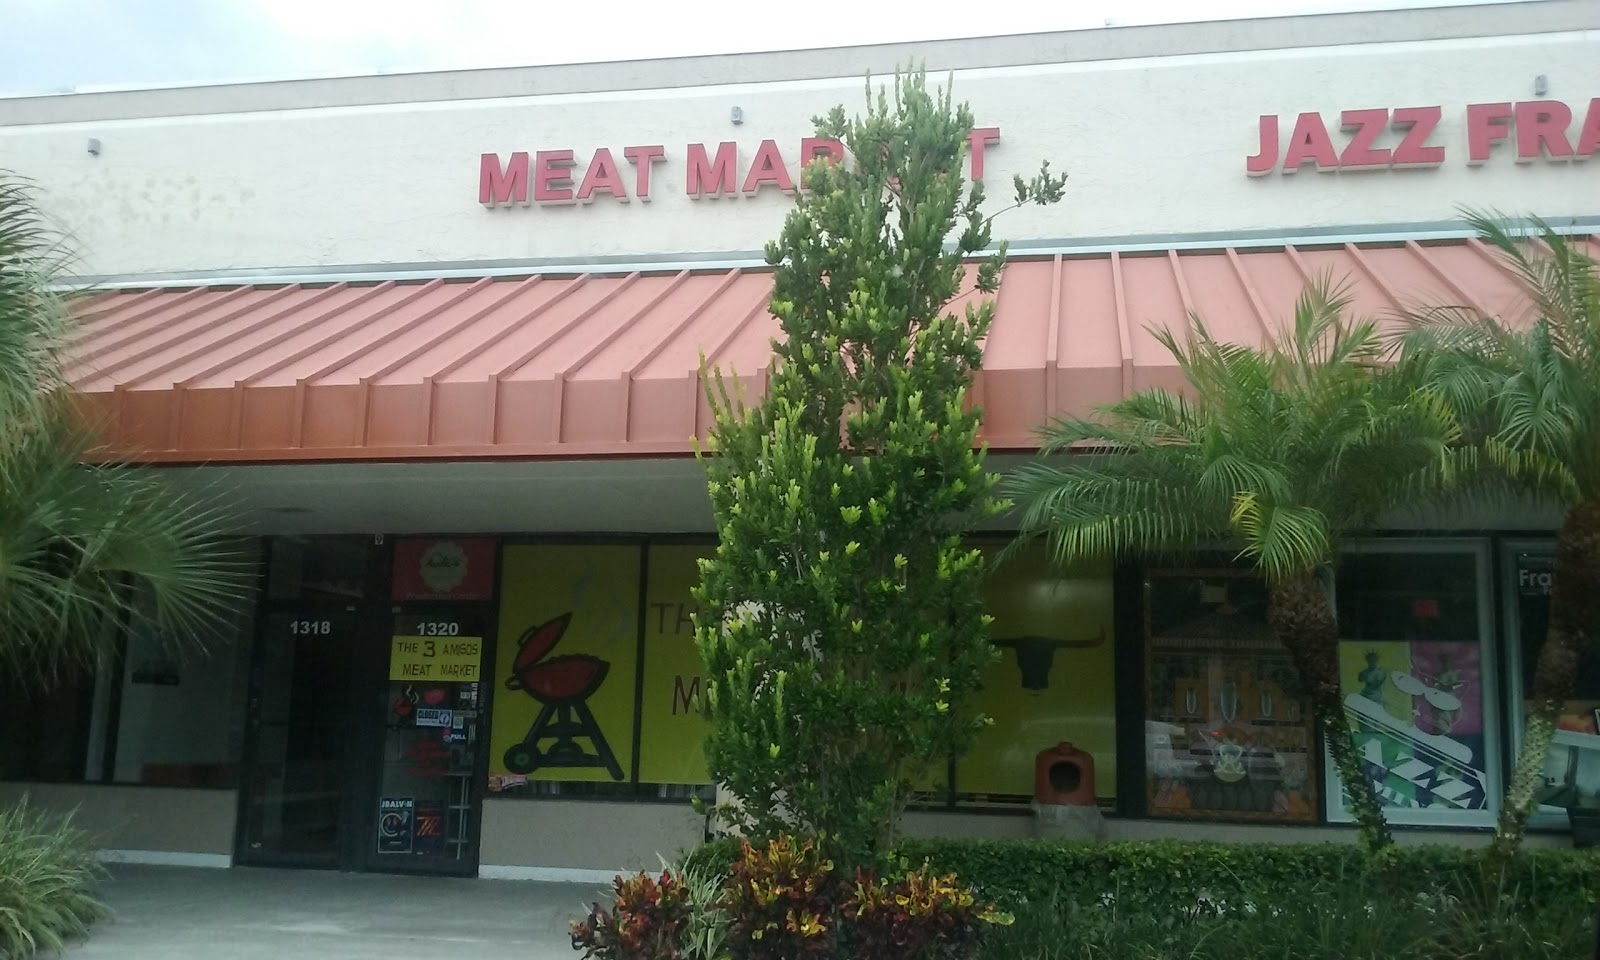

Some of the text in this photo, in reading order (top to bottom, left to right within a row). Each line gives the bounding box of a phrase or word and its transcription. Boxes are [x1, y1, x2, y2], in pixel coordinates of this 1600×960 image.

[1246, 105, 1446, 176] JAZZ
[479, 127, 1001, 207] MEAT MART
[290, 621, 331, 635] 1318
[417, 622, 459, 636] 1320
[398, 640, 479, 657] THE 3 AMIGOS
[402, 663, 477, 676] MEAT MARKET
